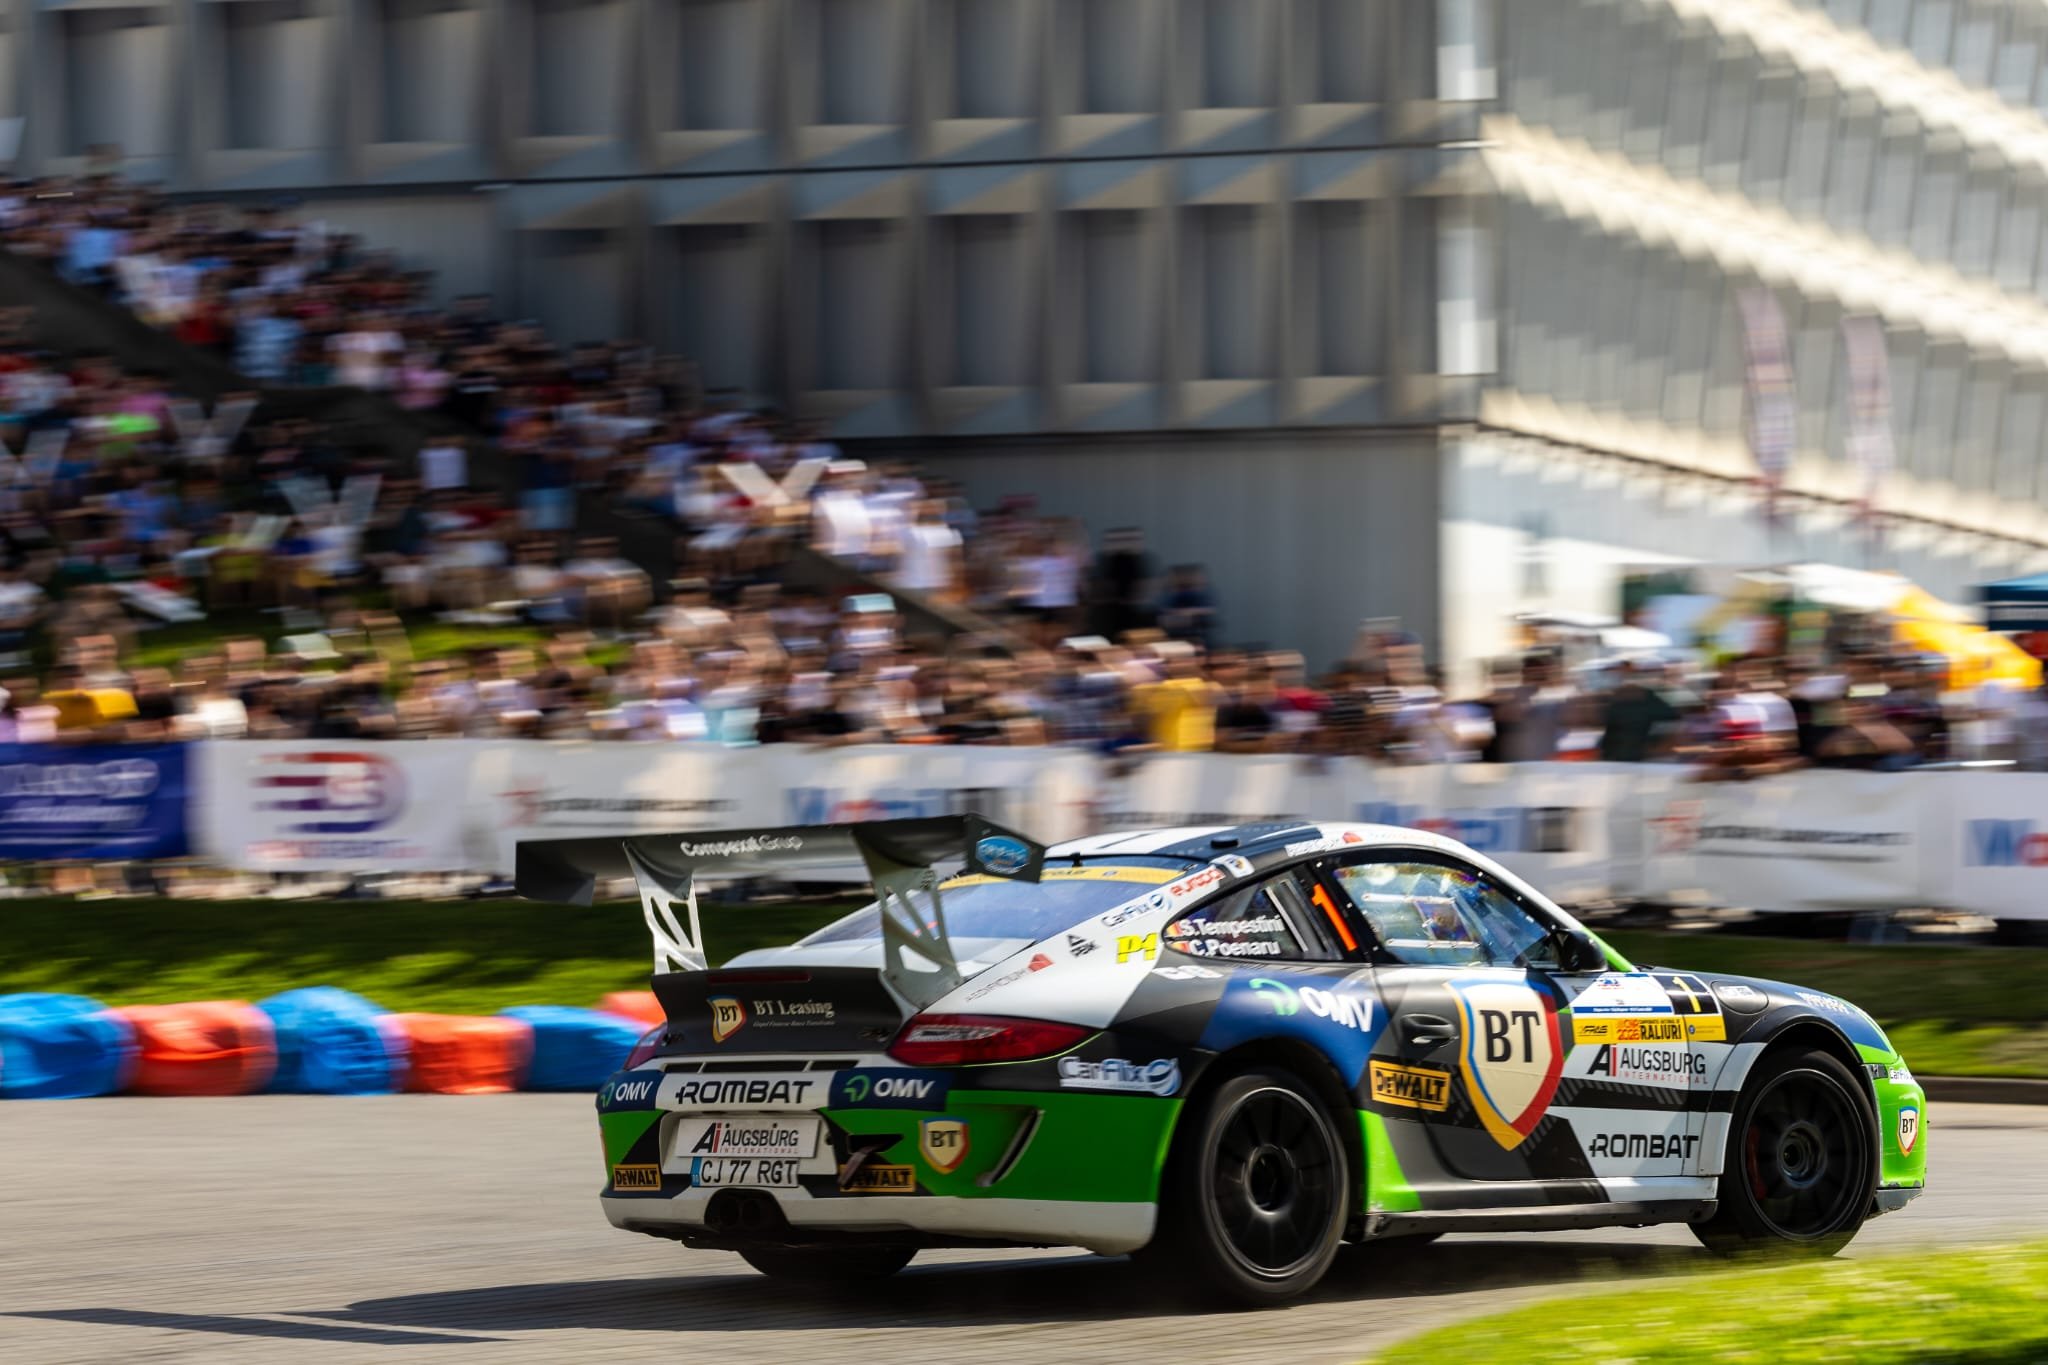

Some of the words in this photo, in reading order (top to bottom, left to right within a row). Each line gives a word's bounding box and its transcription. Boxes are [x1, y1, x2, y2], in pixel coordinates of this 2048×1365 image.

[1180, 913, 1285, 938] S.Tempestini
[1311, 883, 1357, 951] 1
[1672, 977, 1702, 1012] 1
[718, 1005, 738, 1021] BT
[753, 1000, 774, 1015] BT
[778, 1000, 835, 1018] Leasing
[1299, 986, 1373, 1033] OMV
[1480, 1010, 1541, 1063] BT
[1641, 1024, 1682, 1040] RALIURI
[1620, 1048, 1706, 1075] AUGSBURG
[1618, 1070, 1708, 1084] INTERNATIONAL
[615, 1081, 653, 1102] OMV
[675, 1081, 813, 1104] ROMBAT
[874, 1078, 935, 1099] OMV
[1902, 1118, 1915, 1134] BT
[722, 1129, 799, 1147] AUGSBURG
[928, 1130, 960, 1148] BT
[1589, 1133, 1699, 1159] ROMBAT
[701, 1160, 723, 1184] CJ
[729, 1160, 752, 1184] 77
[757, 1160, 799, 1185] RGT
